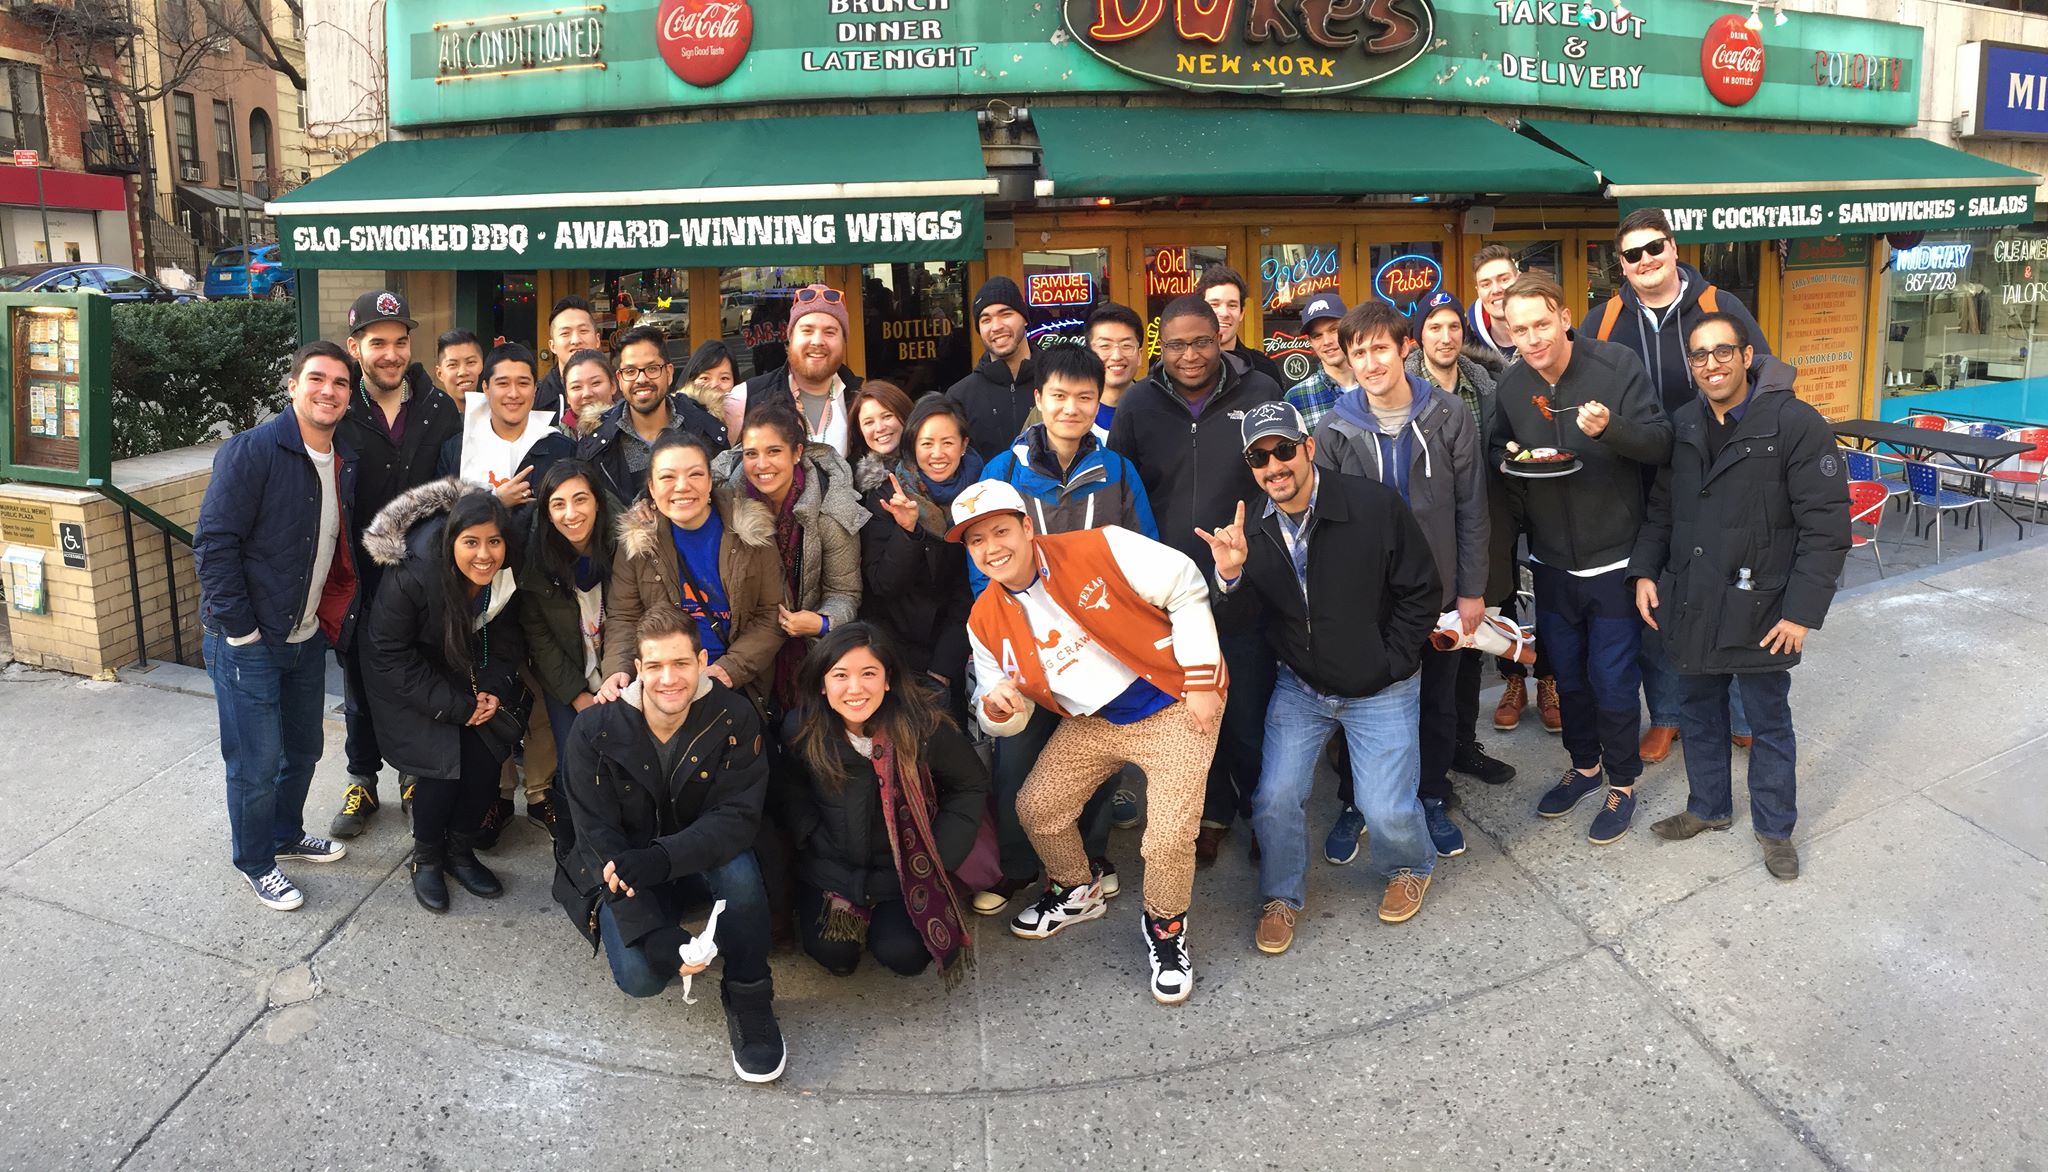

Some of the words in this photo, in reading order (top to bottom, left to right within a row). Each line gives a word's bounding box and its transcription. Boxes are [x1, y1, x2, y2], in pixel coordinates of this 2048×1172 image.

[829, 0, 949, 14] BRUNCH
[837, 19, 943, 43] DINNER
[1730, 31, 1748, 40] DRINK
[1563, 36, 1588, 58] &
[1711, 43, 1762, 72] Coca-Cola
[1176, 54, 1240, 75] NEW
[1262, 55, 1336, 77] YORK
[1502, 53, 1644, 89] DELIVERY
[1722, 76, 1730, 84] IN
[1731, 77, 1754, 86] BOTTLES
[1712, 203, 1823, 231] COCKTAILS
[1839, 199, 1956, 224] SANDWICHES
[1968, 194, 2029, 217] SALADS
[292, 224, 470, 252] SLO-SMOKED
[470, 223, 529, 255] BBQ
[553, 213, 837, 250] AWARD-WINNING
[845, 210, 963, 243] WINGS
[1157, 248, 1187, 274] Old
[1896, 244, 1971, 271] MIDWAY
[1994, 238, 2048, 264] CLEANE
[1031, 273, 1089, 290] SAMUEL
[1385, 266, 1433, 295] Pabst
[1031, 288, 1089, 304] ADAMS
[882, 318, 952, 340] BOTTLED
[899, 340, 937, 361] BEER
[1262, 336, 1312, 353] Budwe
[1805, 352, 1837, 365] SMOKED
[1838, 350, 1853, 362] BBQ
[1, 510, 18, 519] PUBLIC
[18, 512, 34, 520] PLAZA
[1077, 576, 1105, 608] TEXAS
